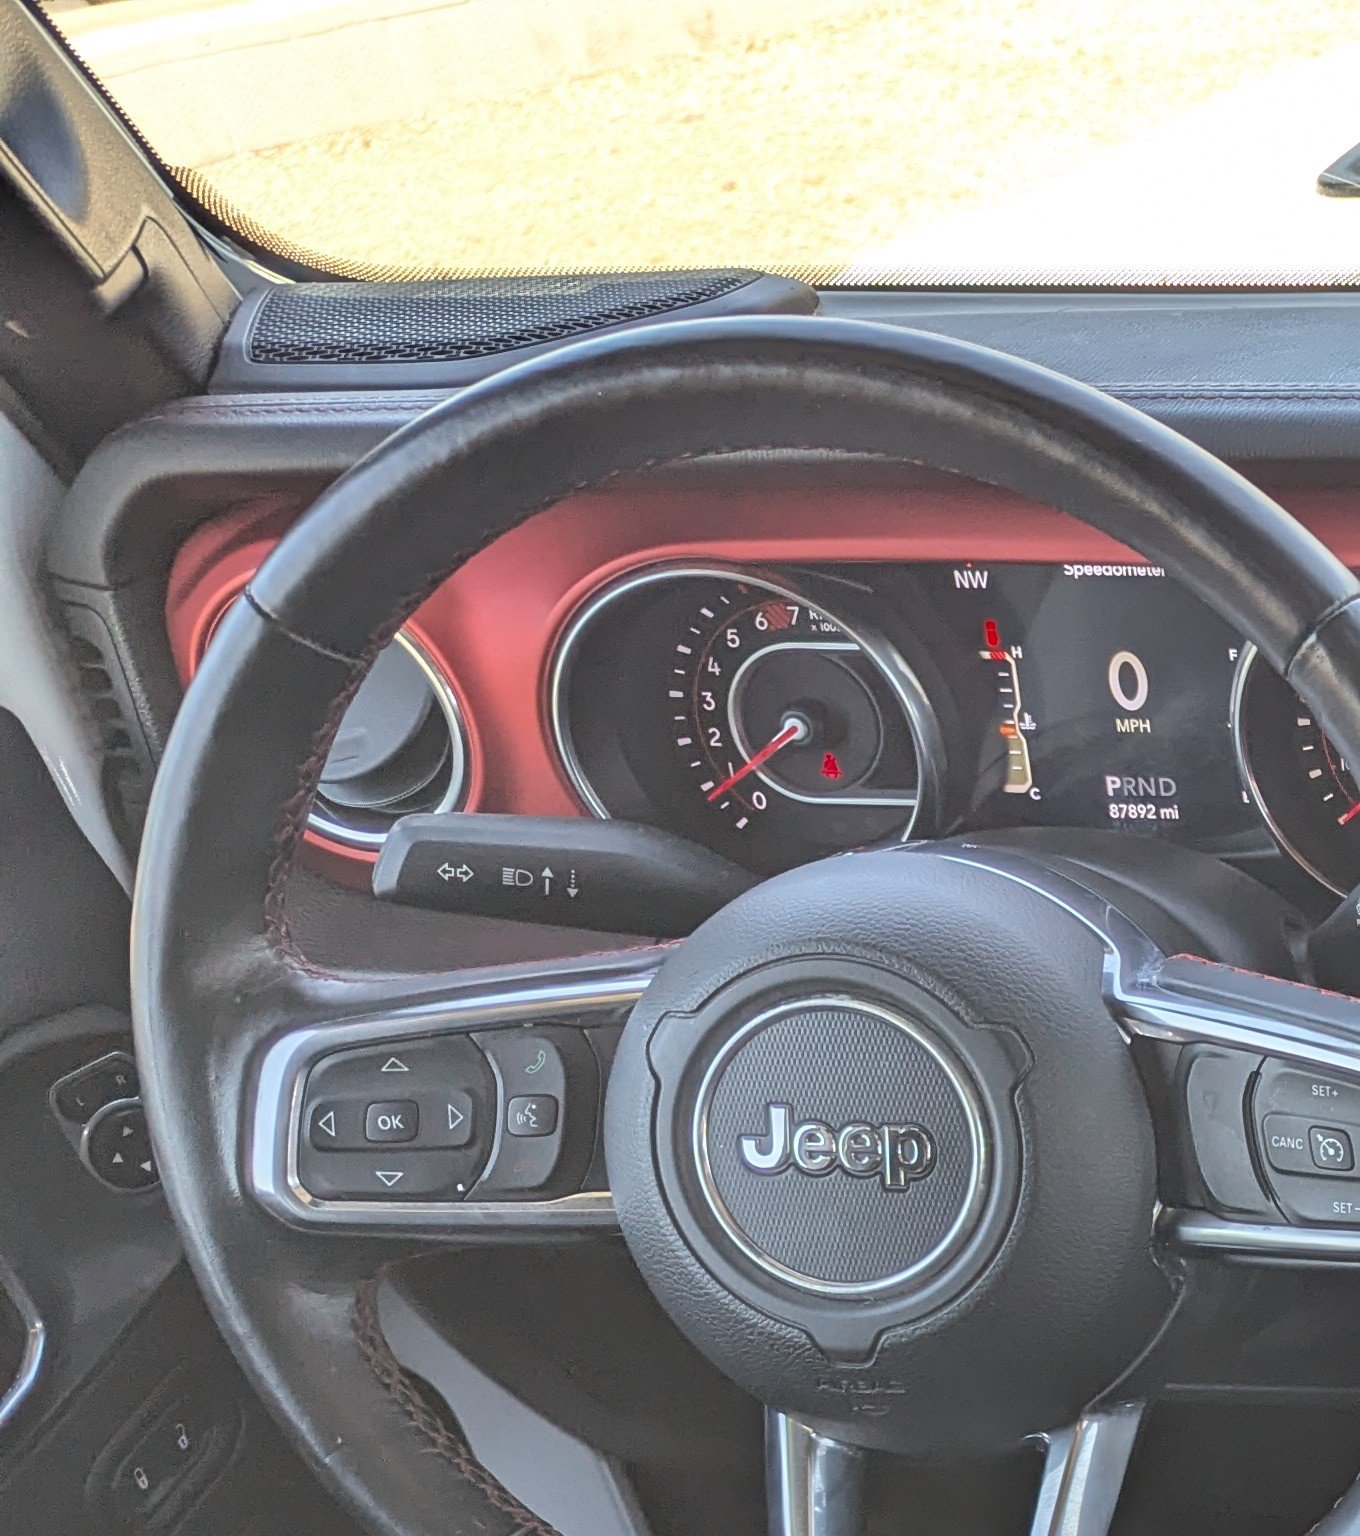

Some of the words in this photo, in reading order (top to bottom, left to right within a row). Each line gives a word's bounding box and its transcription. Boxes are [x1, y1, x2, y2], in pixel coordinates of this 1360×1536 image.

[954, 570, 989, 590] NW
[755, 612, 769, 630] 6
[786, 606, 799, 625] 7
[726, 629, 740, 648] 5
[1010, 645, 1023, 659] H
[1228, 648, 1238, 661] F
[707, 656, 721, 676] 4
[1108, 651, 1149, 712] 0
[701, 691, 716, 711] 3
[1115, 718, 1151, 733] MPH
[708, 727, 722, 747] 2
[1029, 786, 1042, 801] C
[1105, 775, 1177, 797] PRND
[752, 791, 767, 810] 0
[1108, 804, 1157, 819] 87892
[1160, 804, 1179, 820] mi
[377, 1115, 405, 1131] OK
[741, 1103, 934, 1189] Jeep
[1271, 1136, 1304, 1150] CANC
